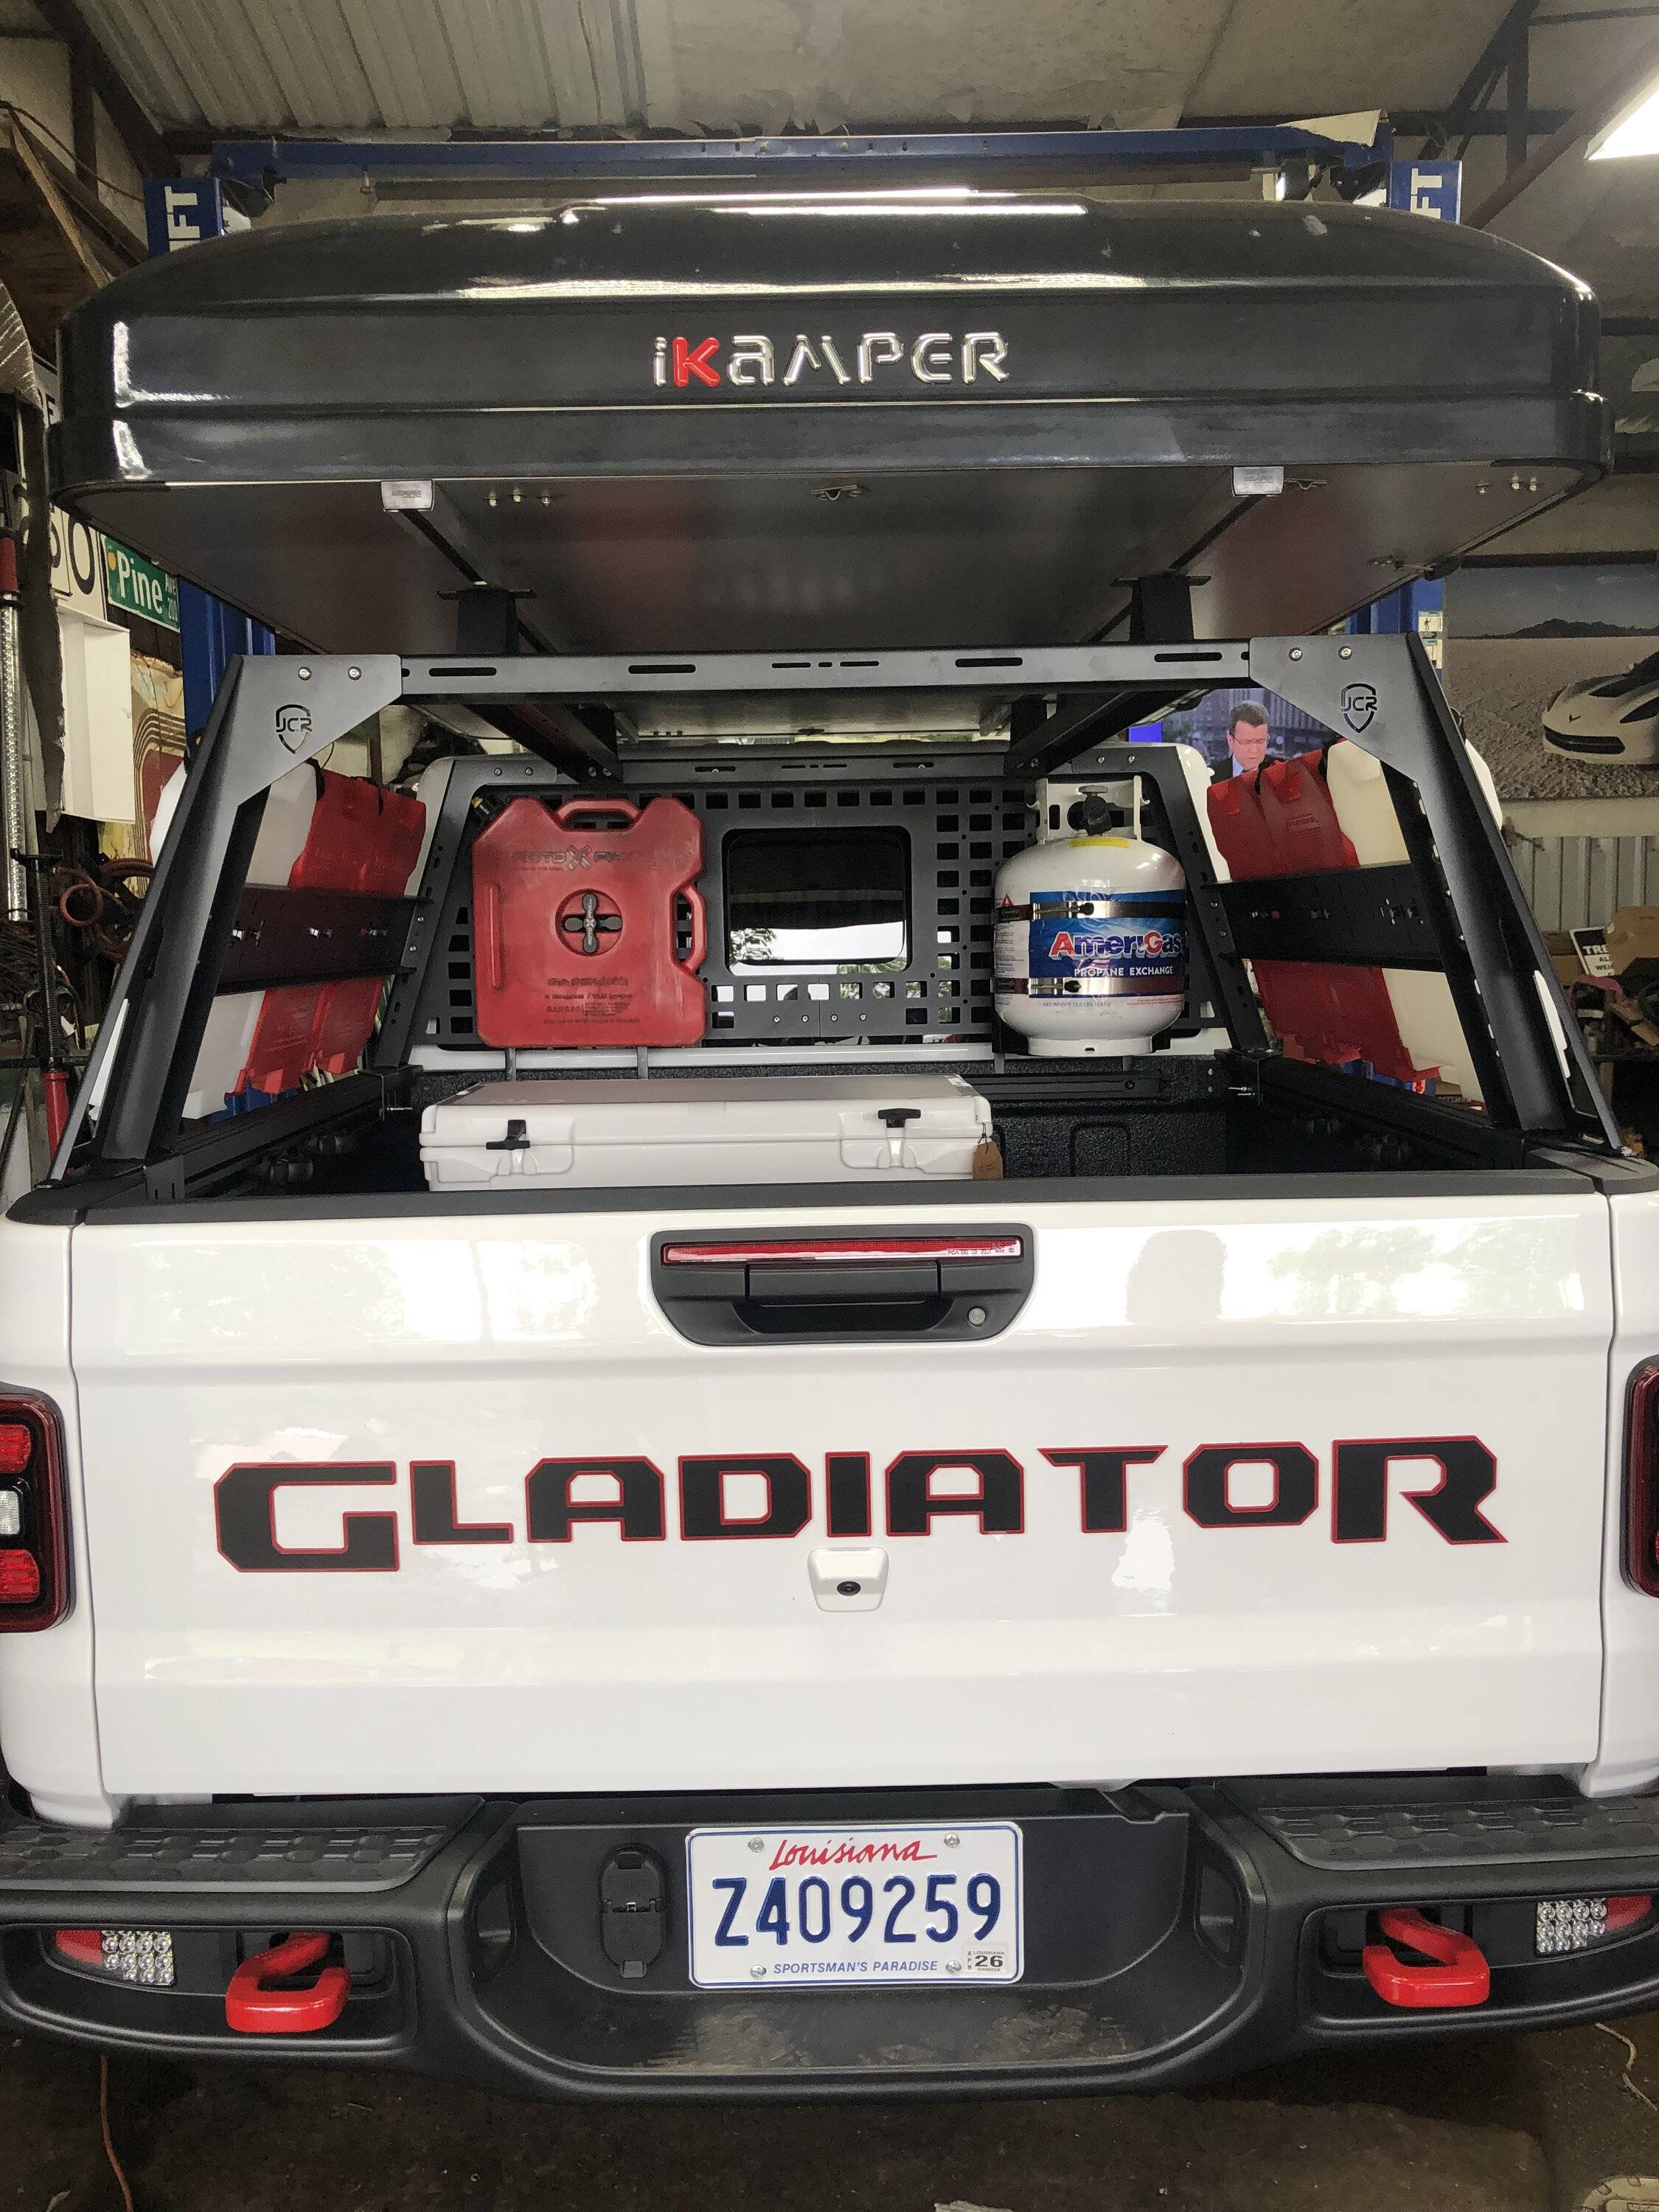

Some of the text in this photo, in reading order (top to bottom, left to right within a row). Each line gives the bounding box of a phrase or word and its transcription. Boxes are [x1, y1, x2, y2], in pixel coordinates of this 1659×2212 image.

[117, 550, 162, 614] Pine
[1341, 697, 1377, 712] JCR
[276, 717, 313, 732] JCR
[1049, 930, 1181, 959] AmeriGas
[1074, 966, 1173, 978] PROPANE EXCHANGE
[214, 1435, 1509, 1572] GLADIATOR
[768, 1837, 938, 1871] Louisiana
[712, 1873, 1001, 1947] Z409259
[773, 1960, 938, 1975] SPORTSMAN'S PARADISE
[975, 1955, 1004, 1968] 26
